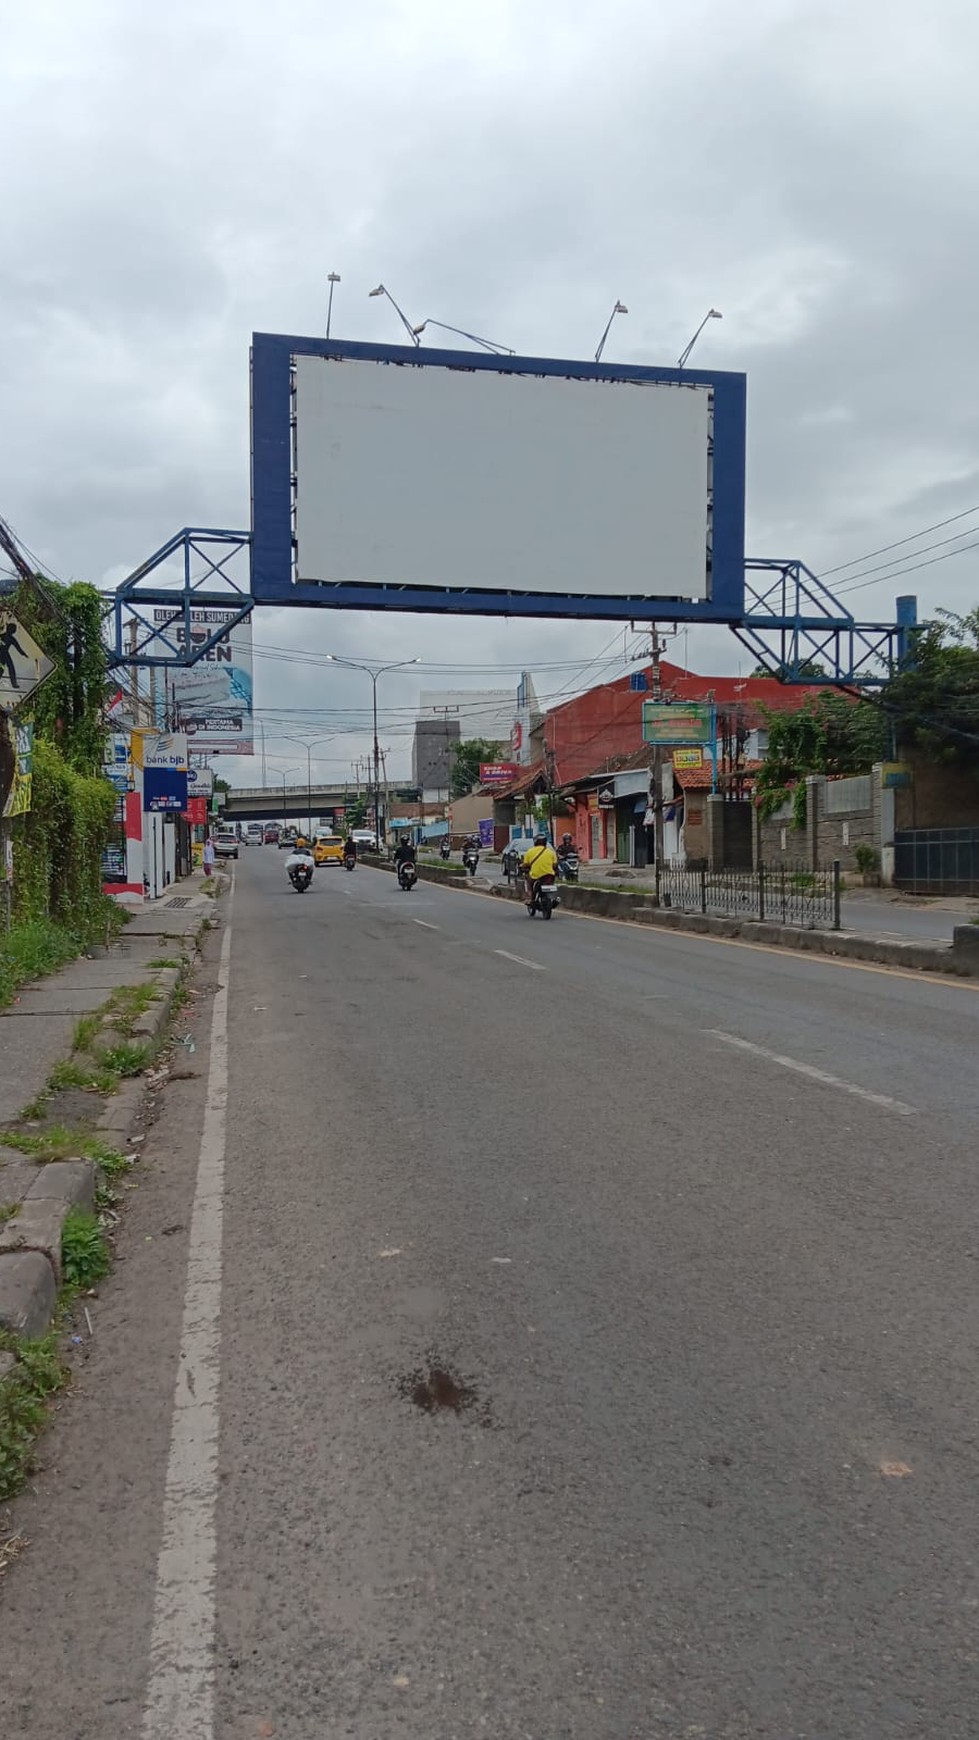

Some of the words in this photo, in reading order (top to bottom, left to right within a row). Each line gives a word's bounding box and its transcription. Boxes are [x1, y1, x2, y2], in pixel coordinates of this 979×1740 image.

[156, 611, 176, 621] OLEH
[206, 612, 250, 624] SUMEDG
[146, 755, 167, 765] bank
[169, 755, 185, 766] bjb
